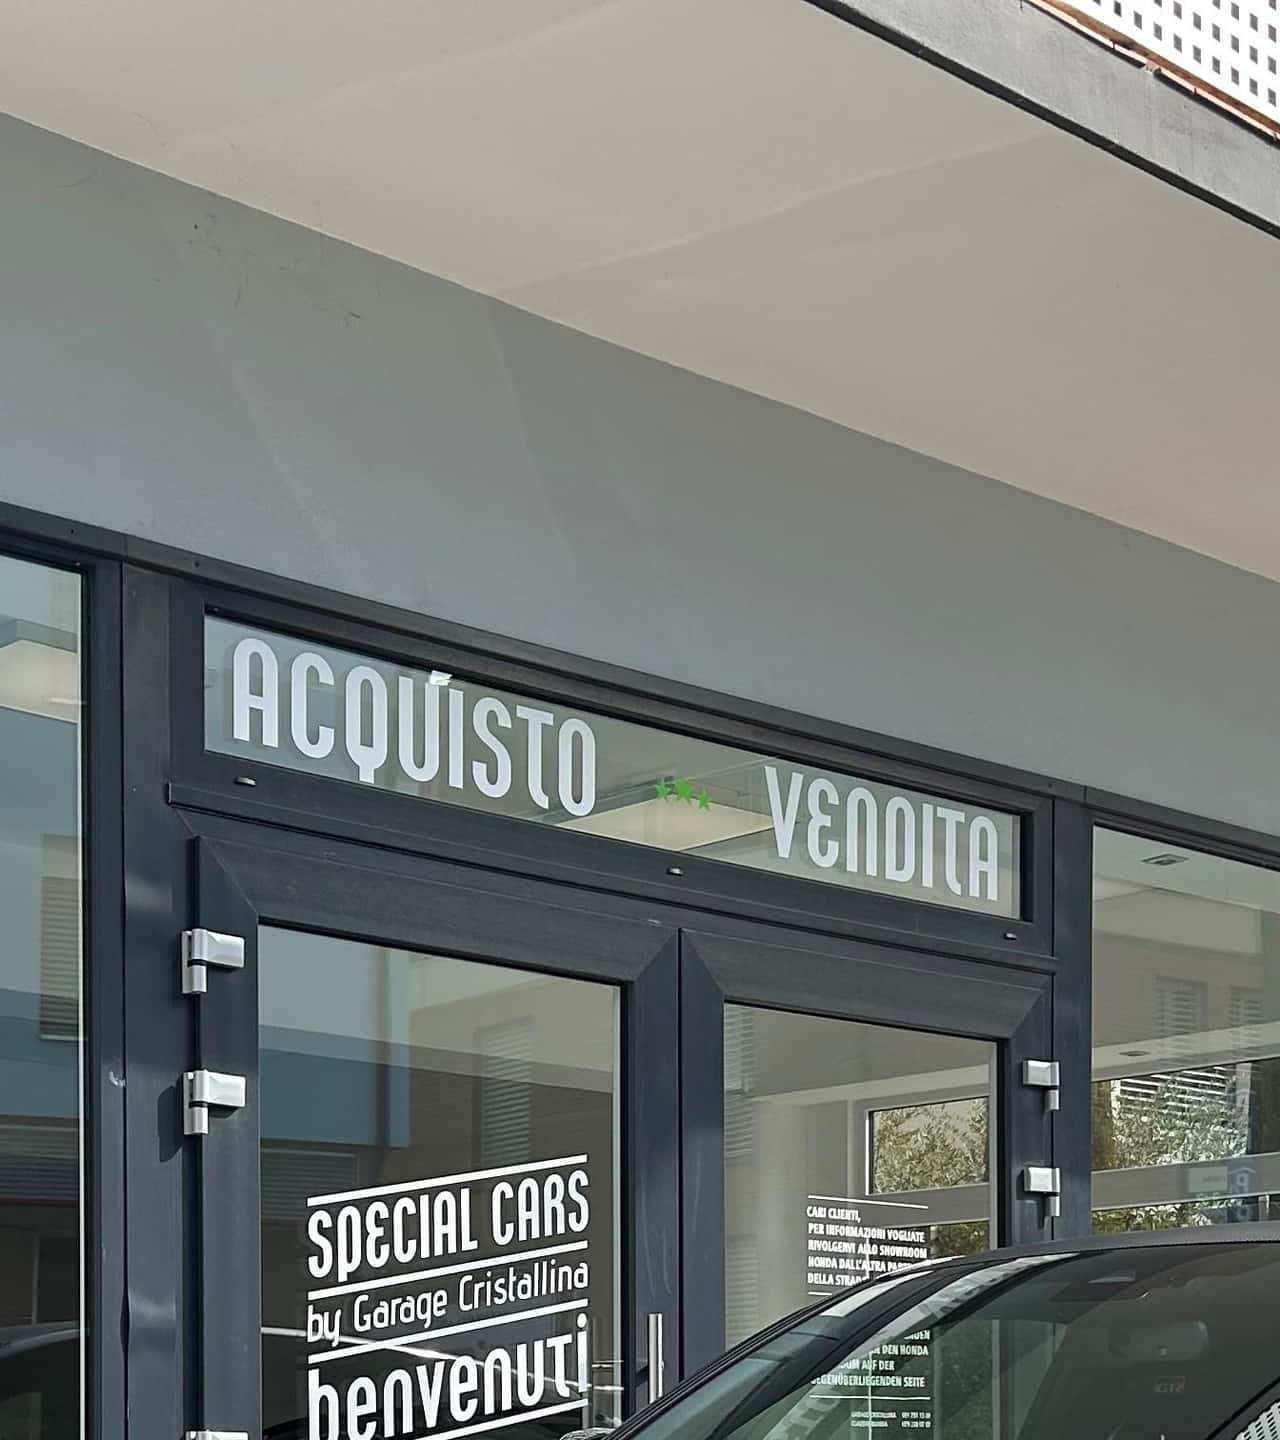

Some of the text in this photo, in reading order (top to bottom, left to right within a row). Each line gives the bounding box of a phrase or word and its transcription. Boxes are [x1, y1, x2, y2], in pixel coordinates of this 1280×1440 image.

[231, 637, 597, 817] ACQUISTO
[763, 764, 999, 903] VENDITA
[806, 1205, 862, 1223] CARI CLIENTI,
[307, 1169, 589, 1283] SPECIAL CARS
[808, 1223, 925, 1243] PER INFORMAZIONI VOGLIATE
[807, 1239, 928, 1259] RIVOLGERVI ALLO SHOWROOM
[808, 1256, 838, 1269] HONDA
[807, 1272, 835, 1286] DELLA
[307, 1257, 589, 1347] by Garage Cristallina
[882, 1344, 899, 1355] DEN
[900, 1344, 929, 1356] HONDA
[878, 1360, 895, 1371] DER
[903, 1376, 926, 1388] SEITE
